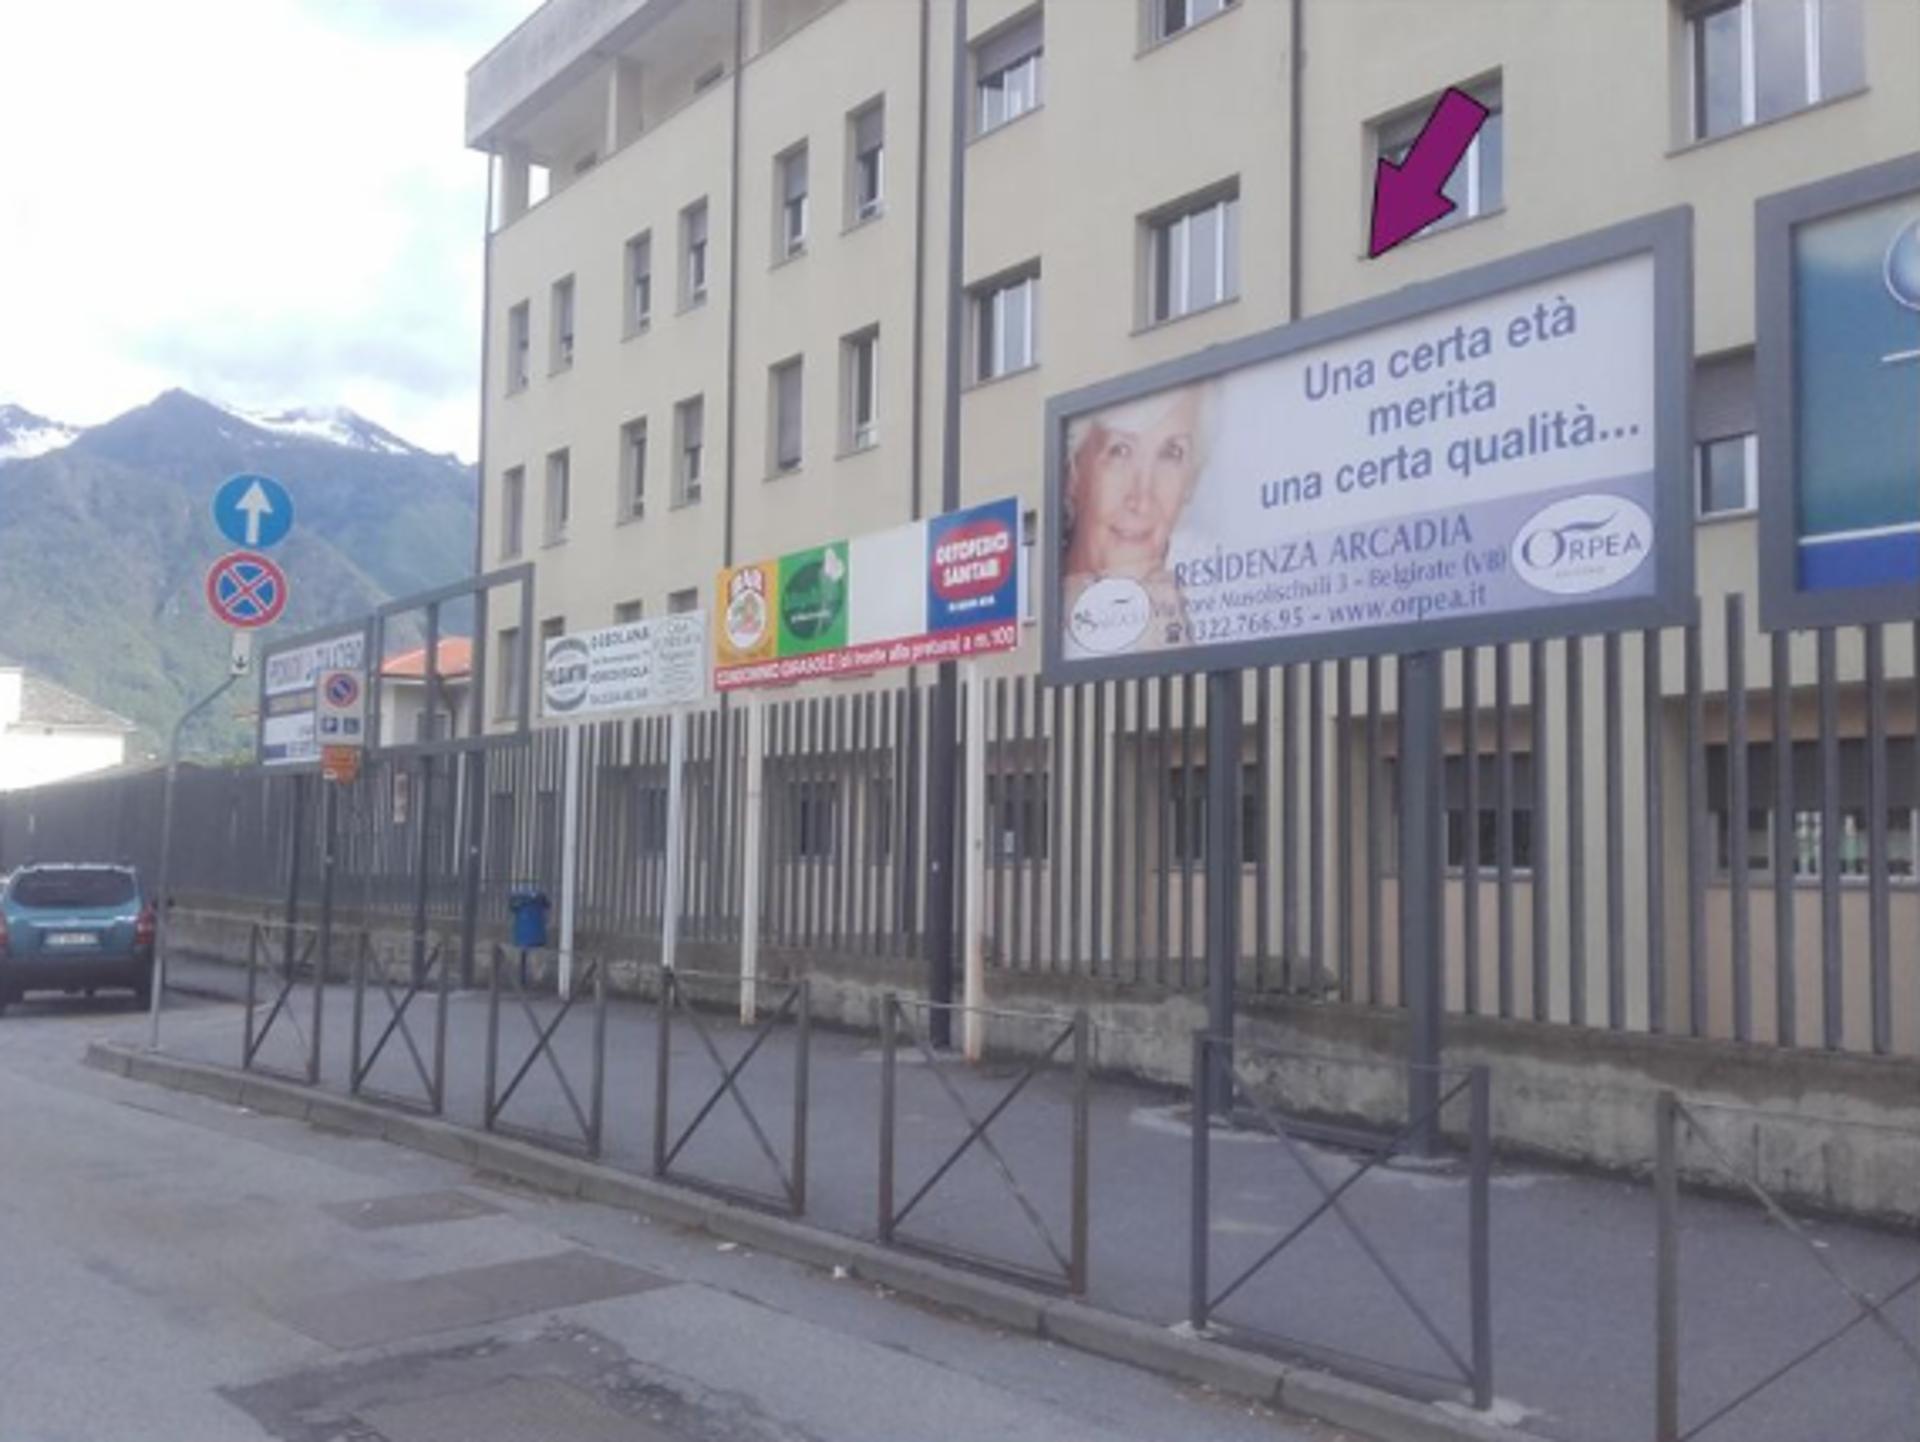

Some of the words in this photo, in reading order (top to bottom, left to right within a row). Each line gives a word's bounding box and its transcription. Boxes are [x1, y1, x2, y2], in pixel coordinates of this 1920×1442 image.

[1305, 358, 1376, 401] Una
[1388, 325, 1491, 379] certa
[1508, 294, 1576, 348] età
[1368, 378, 1496, 436] merita
[1261, 471, 1323, 509] una
[1335, 445, 1433, 493] certa
[1447, 402, 1640, 478] qualità...
[1174, 539, 1318, 590] RESIDENZA
[1329, 513, 1473, 564] ARCADIA
[1369, 559, 1456, 591] Belgirate
[1521, 526, 1642, 570] ORPEA
[1328, 580, 1486, 624] www.orpea.it
